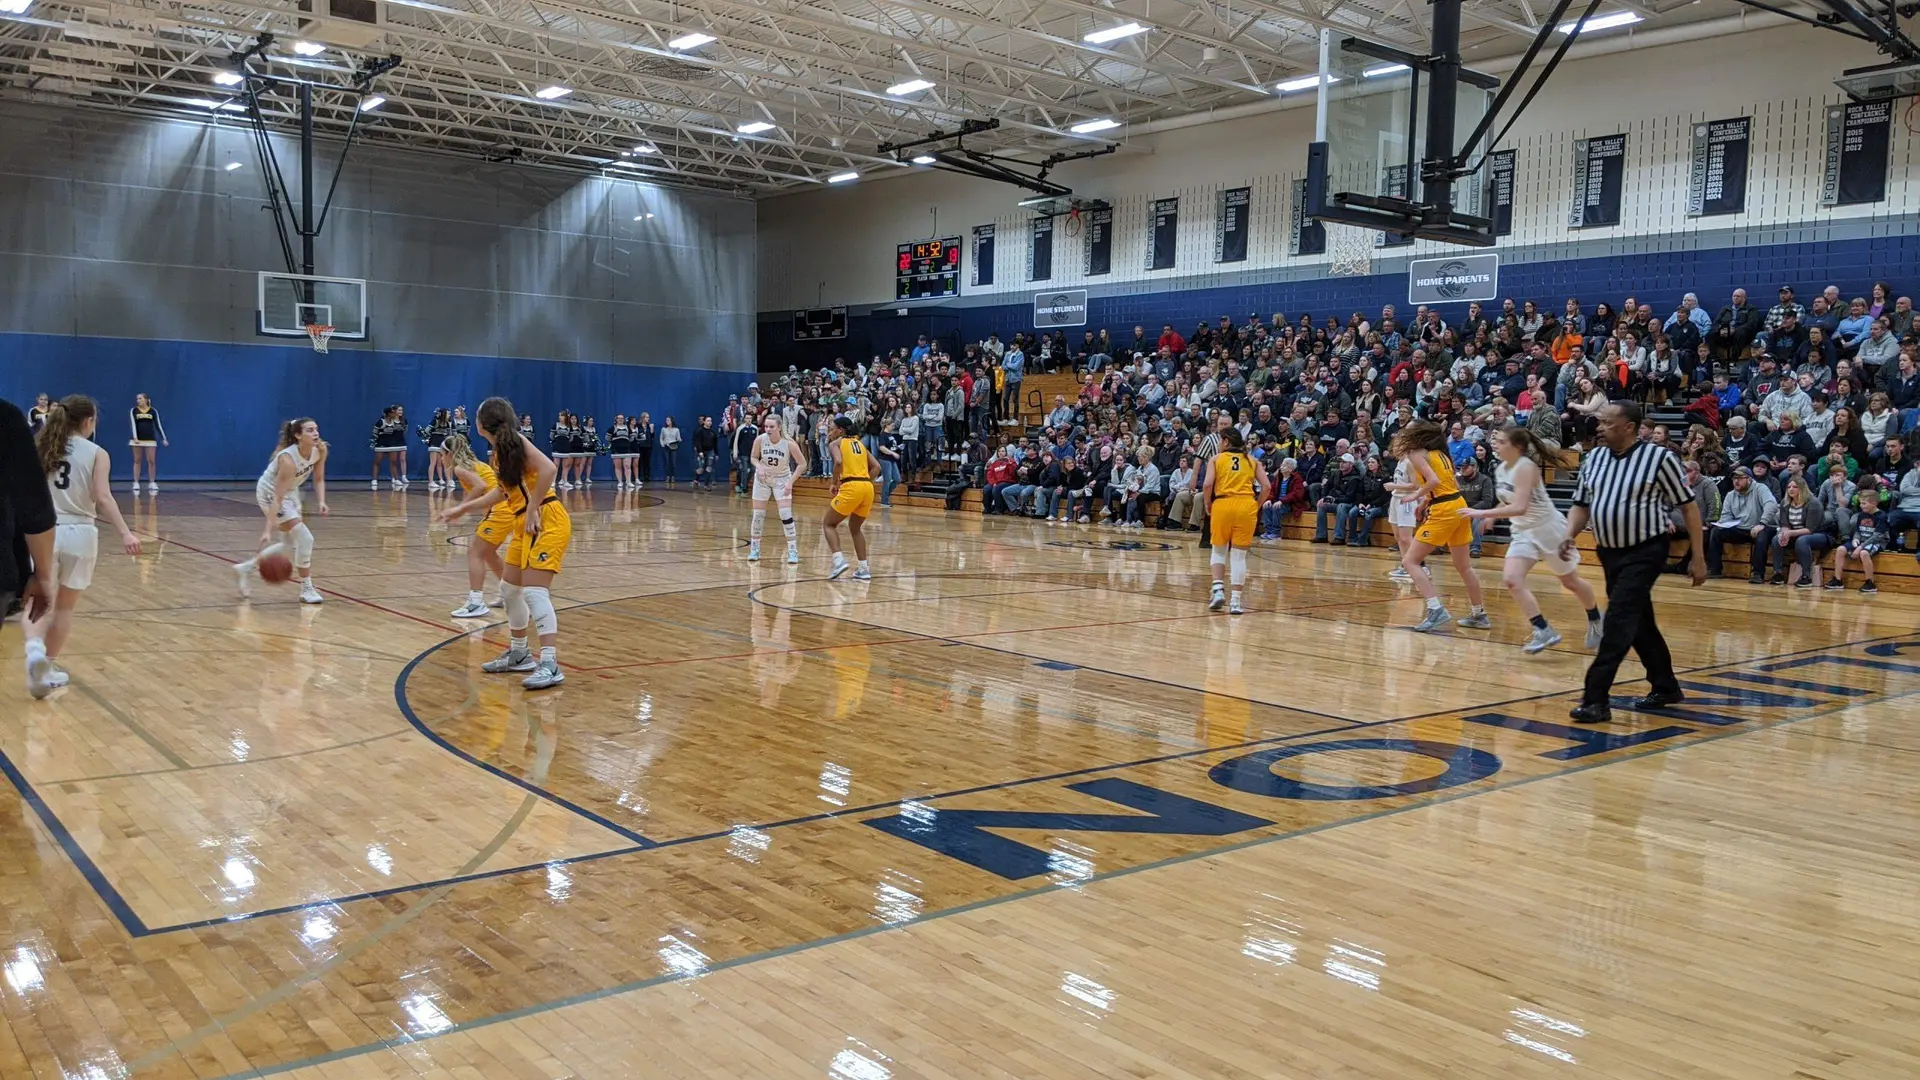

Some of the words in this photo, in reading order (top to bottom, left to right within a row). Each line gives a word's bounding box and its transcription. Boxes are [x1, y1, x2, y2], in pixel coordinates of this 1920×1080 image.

[1847, 106, 1863, 114] ROCK
[1865, 102, 1890, 110] VALLEY
[1850, 110, 1886, 119] CONFERENCE
[1727, 121, 1747, 129] VALLEY
[1846, 116, 1889, 126] CHAMPIONSHIPS
[1709, 133, 1747, 143] CHAMPIONSHIPS
[1713, 128, 1744, 136] CONFERENCE
[1845, 144, 1862, 152] 2017
[1824, 126, 1840, 200] FOOTBALL
[1691, 142, 1704, 212] VOLLEYBALL
[1572, 160, 1584, 223] WRESTLING
[1292, 205, 1300, 249] TRACK
[1216, 215, 1224, 255] TRACK
[1145, 216, 1155, 268] SOFTBALL
[930, 262, 936, 273] 2
[905, 283, 910, 294] 2
[948, 279, 953, 290] 0
[1416, 277, 1443, 287] HOME
[1445, 274, 1490, 285] PARENTS
[1054, 305, 1084, 313] STUDENTS
[763, 449, 785, 457] CLINTON
[851, 441, 861, 454] 10
[767, 457, 779, 467] 23
[1232, 457, 1239, 471] 3
[1438, 453, 1449, 469] 11
[54, 460, 71, 490] 3
[860, 641, 1920, 880] LINTON
